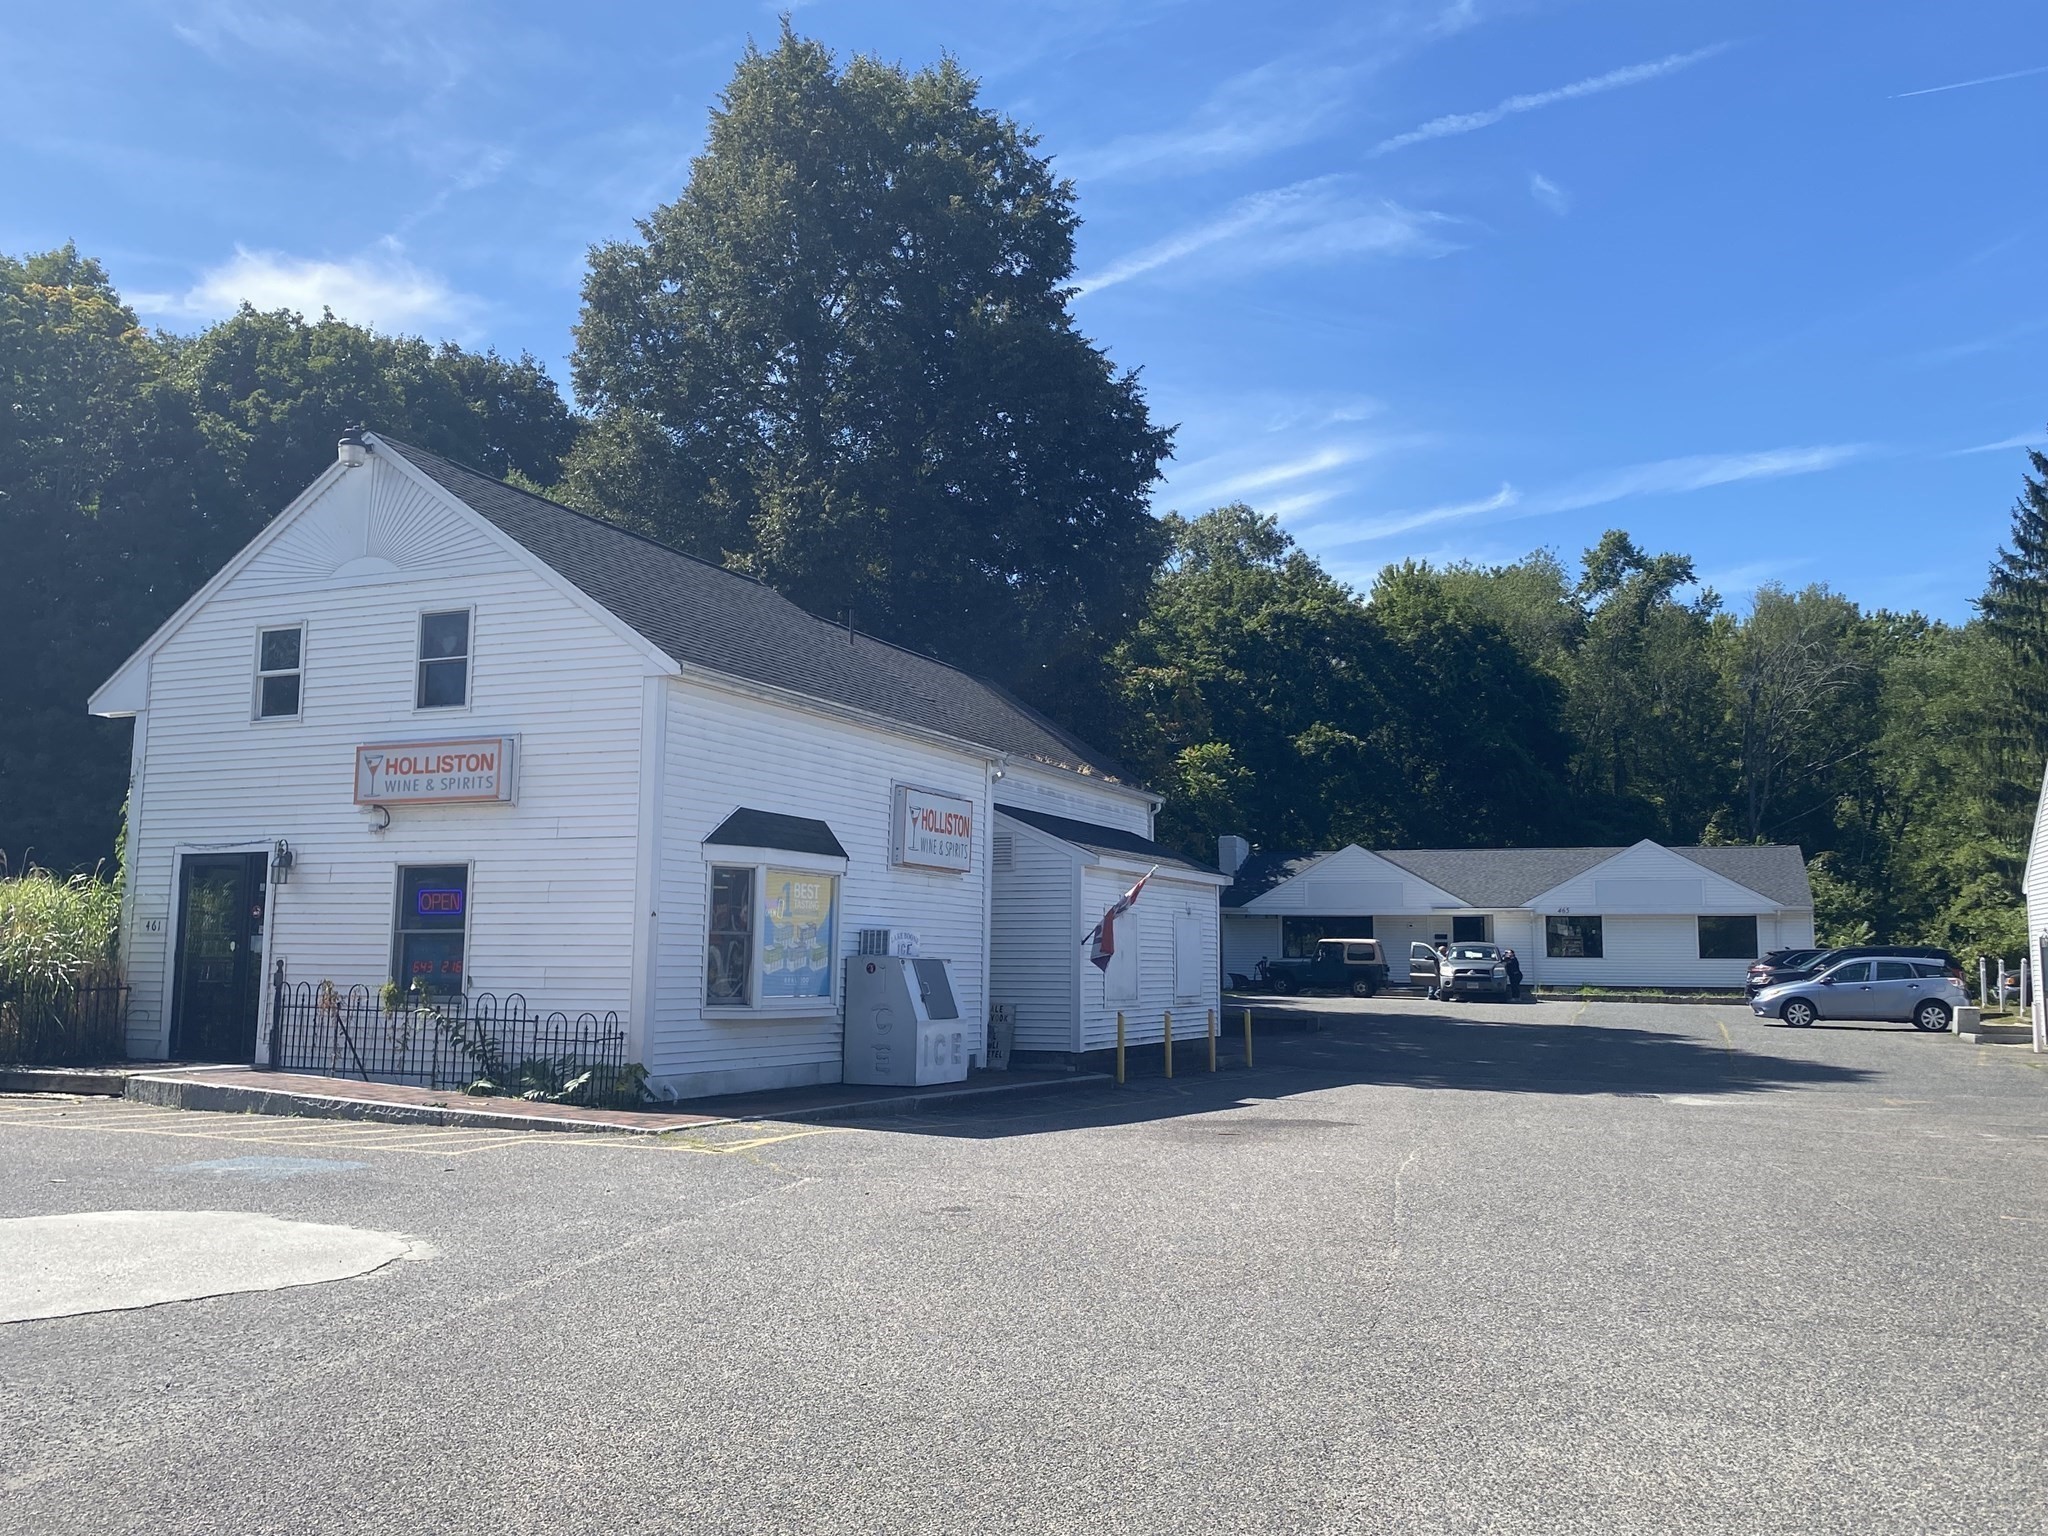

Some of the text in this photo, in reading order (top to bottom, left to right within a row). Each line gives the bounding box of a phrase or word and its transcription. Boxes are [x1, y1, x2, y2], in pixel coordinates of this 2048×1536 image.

[385, 753, 494, 775] HOLLISTON
[385, 776, 493, 792] WINE & SPIRITS
[921, 808, 970, 838] HOLLISTON
[920, 837, 968, 859] WINE & SPIRITS
[794, 882, 820, 899] BEST
[421, 893, 460, 911] OPEN
[794, 899, 819, 911] TASTING
[146, 920, 160, 931] 461
[897, 943, 913, 955] ICE
[923, 1032, 962, 1067] ICE
